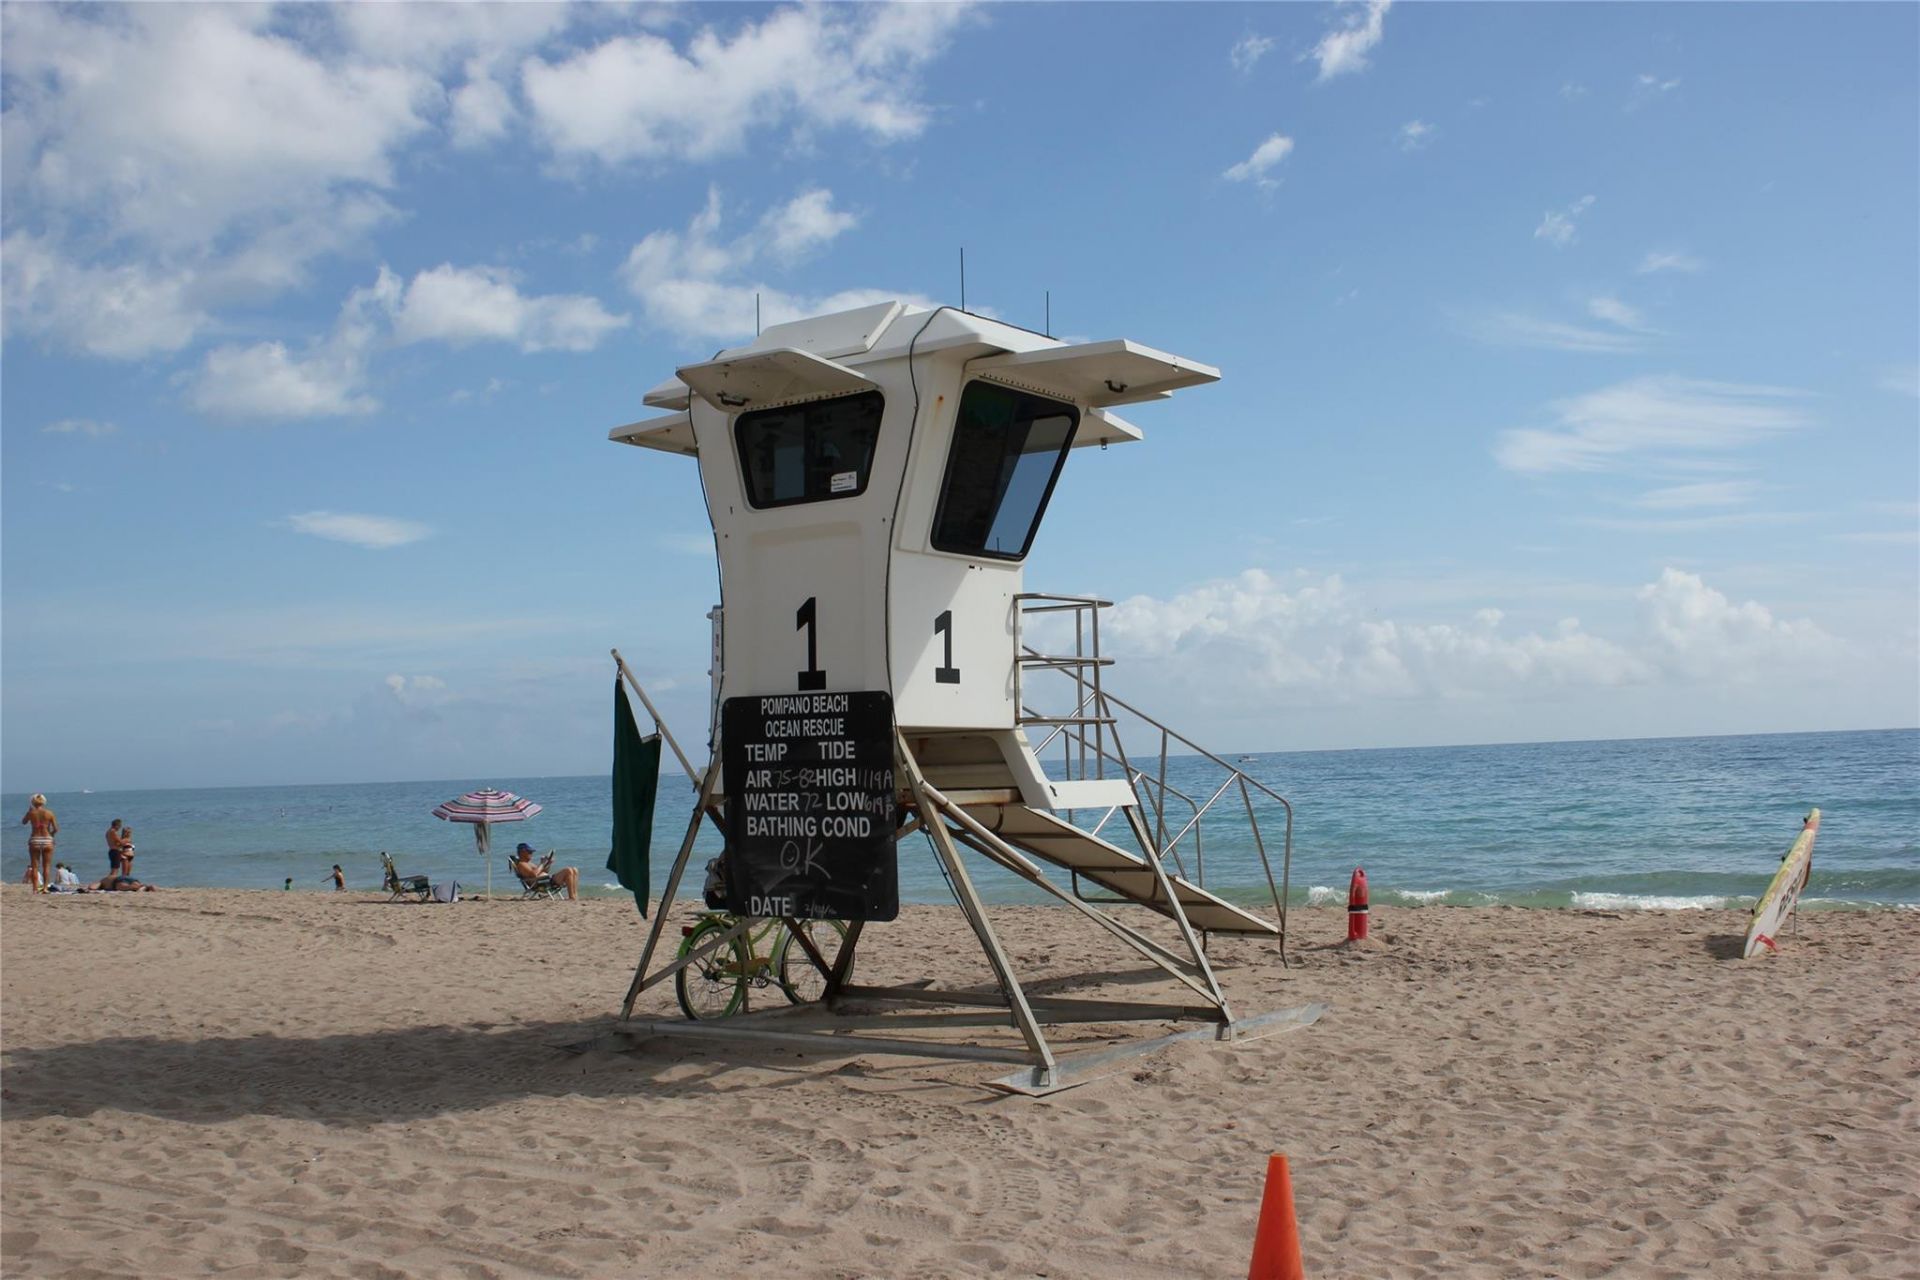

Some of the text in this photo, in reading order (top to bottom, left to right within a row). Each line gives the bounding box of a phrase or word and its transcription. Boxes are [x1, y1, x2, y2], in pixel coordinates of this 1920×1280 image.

[796, 596, 827, 691] 1
[934, 610, 960, 684] 1
[761, 695, 848, 715] POMPANO BEACH
[765, 718, 845, 738] OCEAN RESCUE
[745, 741, 855, 762] TEMP TIDE
[745, 770, 772, 788] AIR
[816, 768, 856, 787] HIGH
[745, 793, 799, 811] WATER
[801, 792, 823, 813] 72
[826, 792, 865, 811] LOW
[747, 817, 870, 837] BATHING COND
[780, 838, 831, 880] OK
[751, 896, 791, 917] DATE
